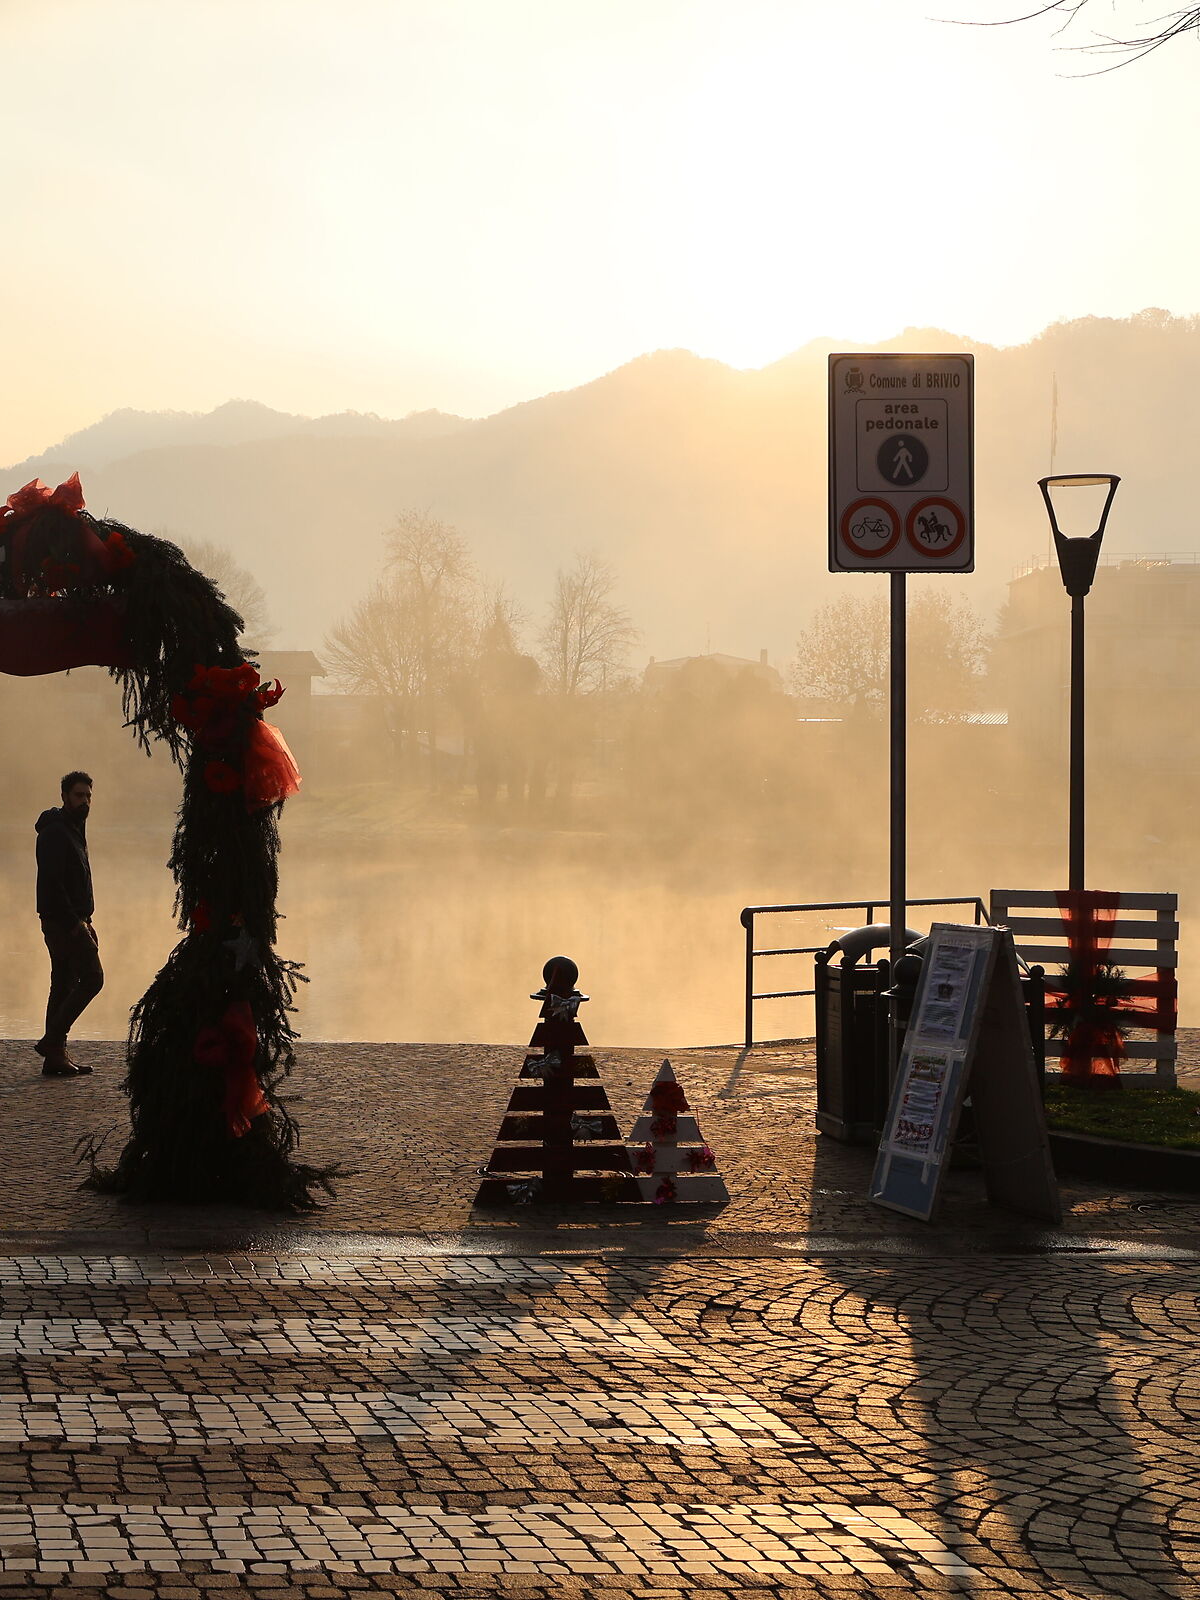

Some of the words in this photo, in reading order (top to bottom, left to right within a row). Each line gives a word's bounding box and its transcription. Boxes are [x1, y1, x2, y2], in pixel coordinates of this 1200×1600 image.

[869, 373, 907, 388] Comune
[912, 372, 921, 388] di
[926, 373, 960, 388] BRIVIO
[884, 404, 919, 414] area
[866, 417, 939, 432] pedonale
